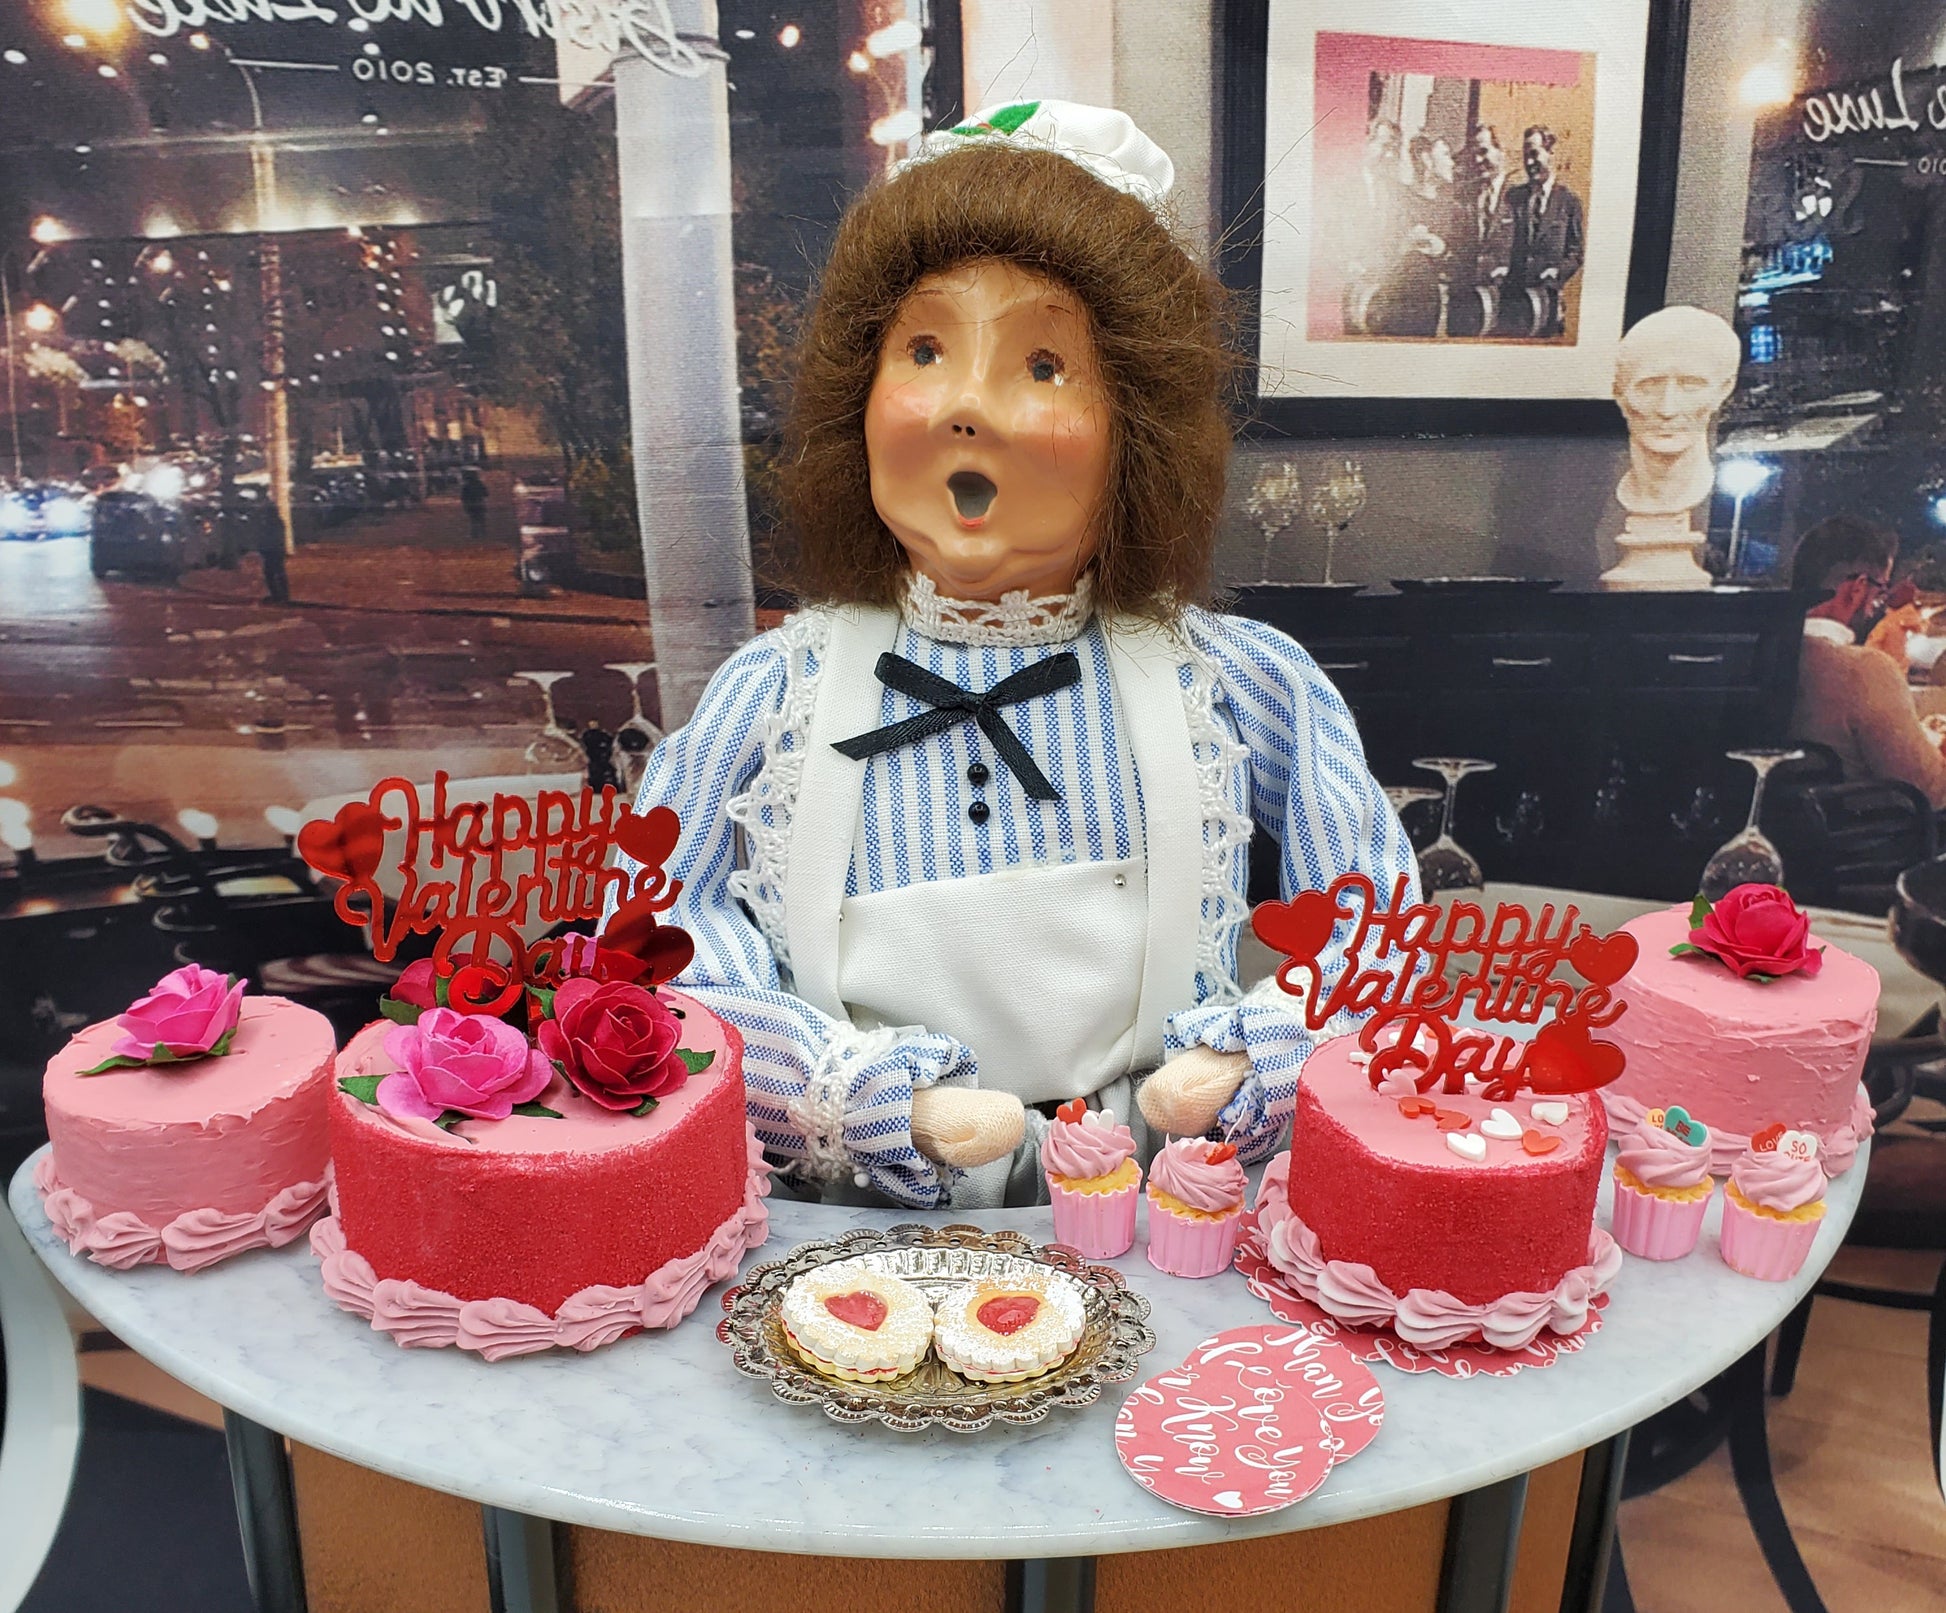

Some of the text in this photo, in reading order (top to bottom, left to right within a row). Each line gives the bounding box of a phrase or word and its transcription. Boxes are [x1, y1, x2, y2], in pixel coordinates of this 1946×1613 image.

[369, 769, 634, 870] Happy
[333, 848, 684, 963] Valentine
[1326, 871, 1592, 978] Happy
[1275, 946, 1629, 1031] Valentine
[1358, 1006, 1534, 1102] Day
[1791, 1140, 1807, 1155] SO
[1234, 1444, 1304, 1500] You
